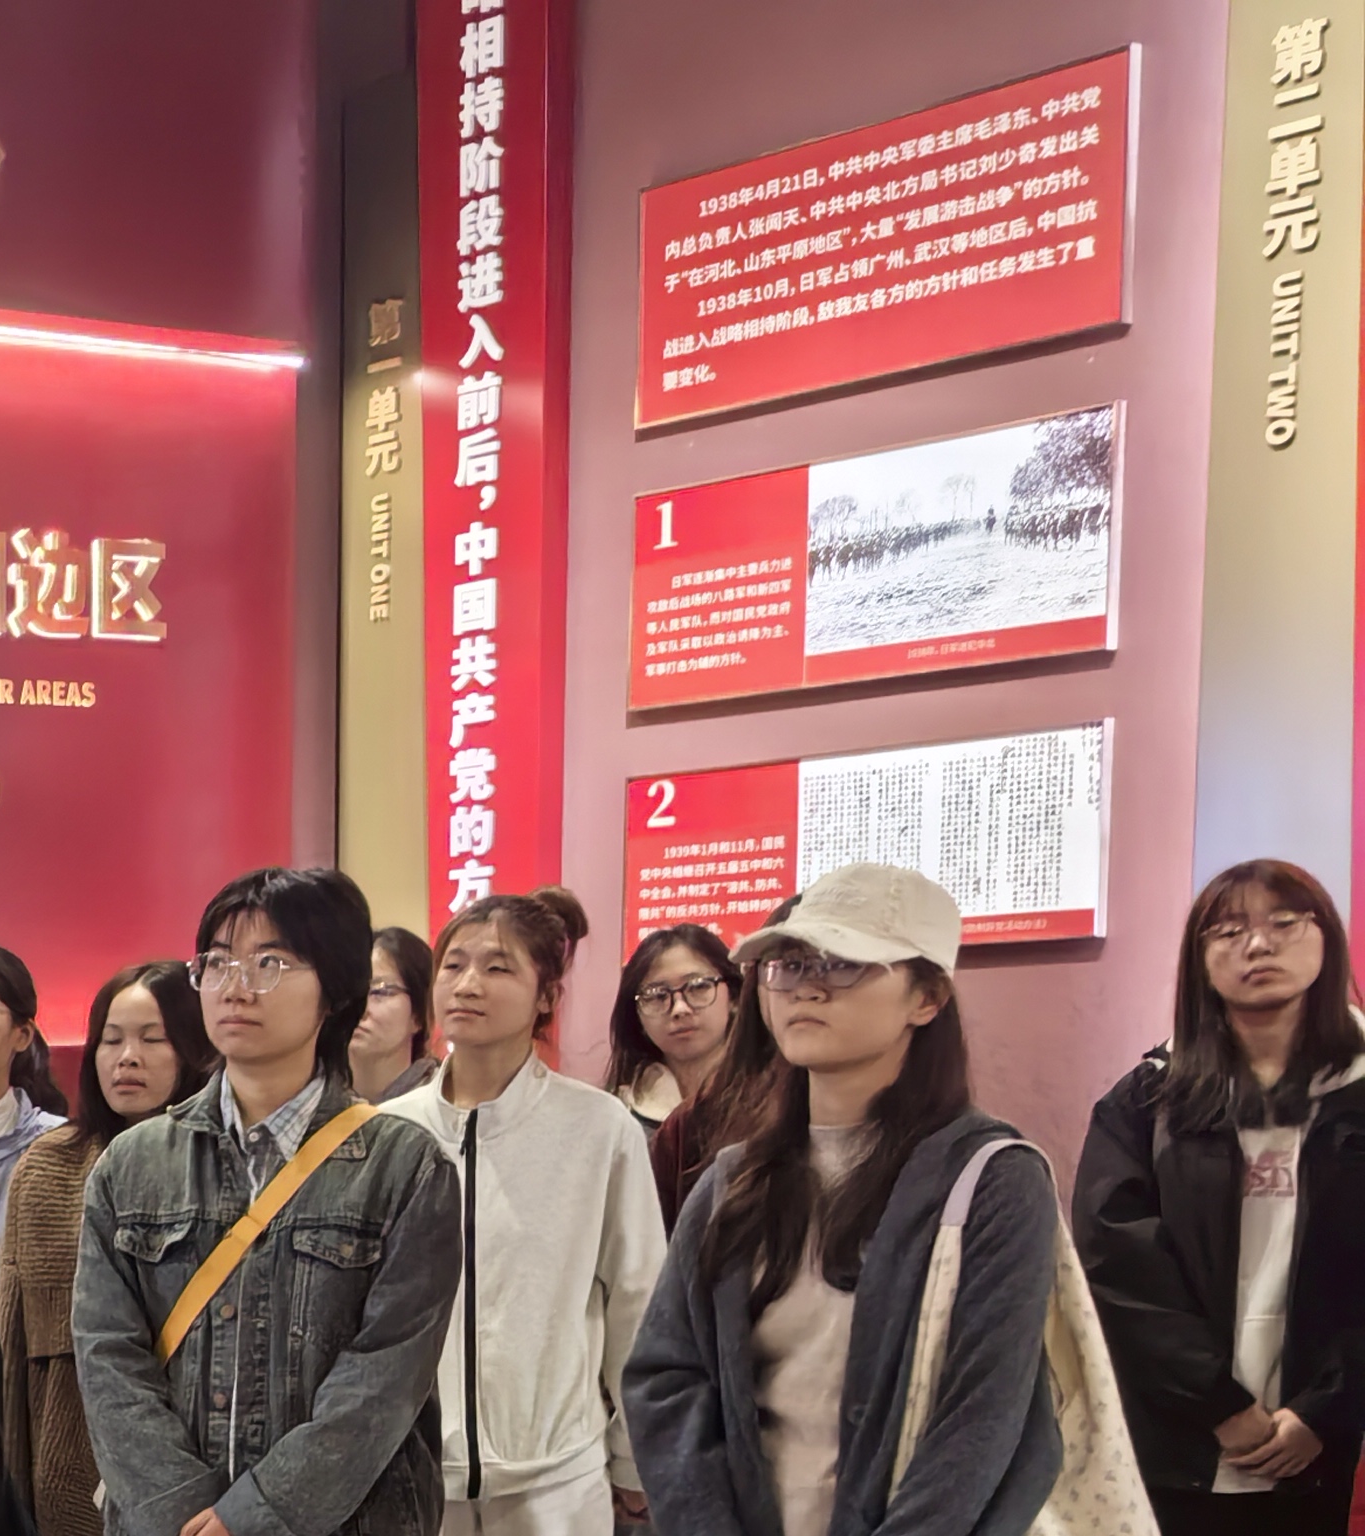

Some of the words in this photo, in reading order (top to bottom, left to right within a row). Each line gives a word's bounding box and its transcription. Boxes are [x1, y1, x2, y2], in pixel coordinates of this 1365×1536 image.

[1262, 17, 1329, 259] 第二单元
[1271, 270, 1303, 358] UNIT
[365, 299, 403, 476] 第一单元
[662, 362, 716, 392] 要变化。
[1265, 361, 1298, 449] TWO
[448, 0, 505, 912] 相持阶段进入前后，中国共产党的方
[370, 493, 391, 559] UNIT
[653, 500, 679, 550] 1
[370, 563, 391, 622] ONE
[21, 679, 96, 708] AREAS
[647, 780, 676, 828] 2
